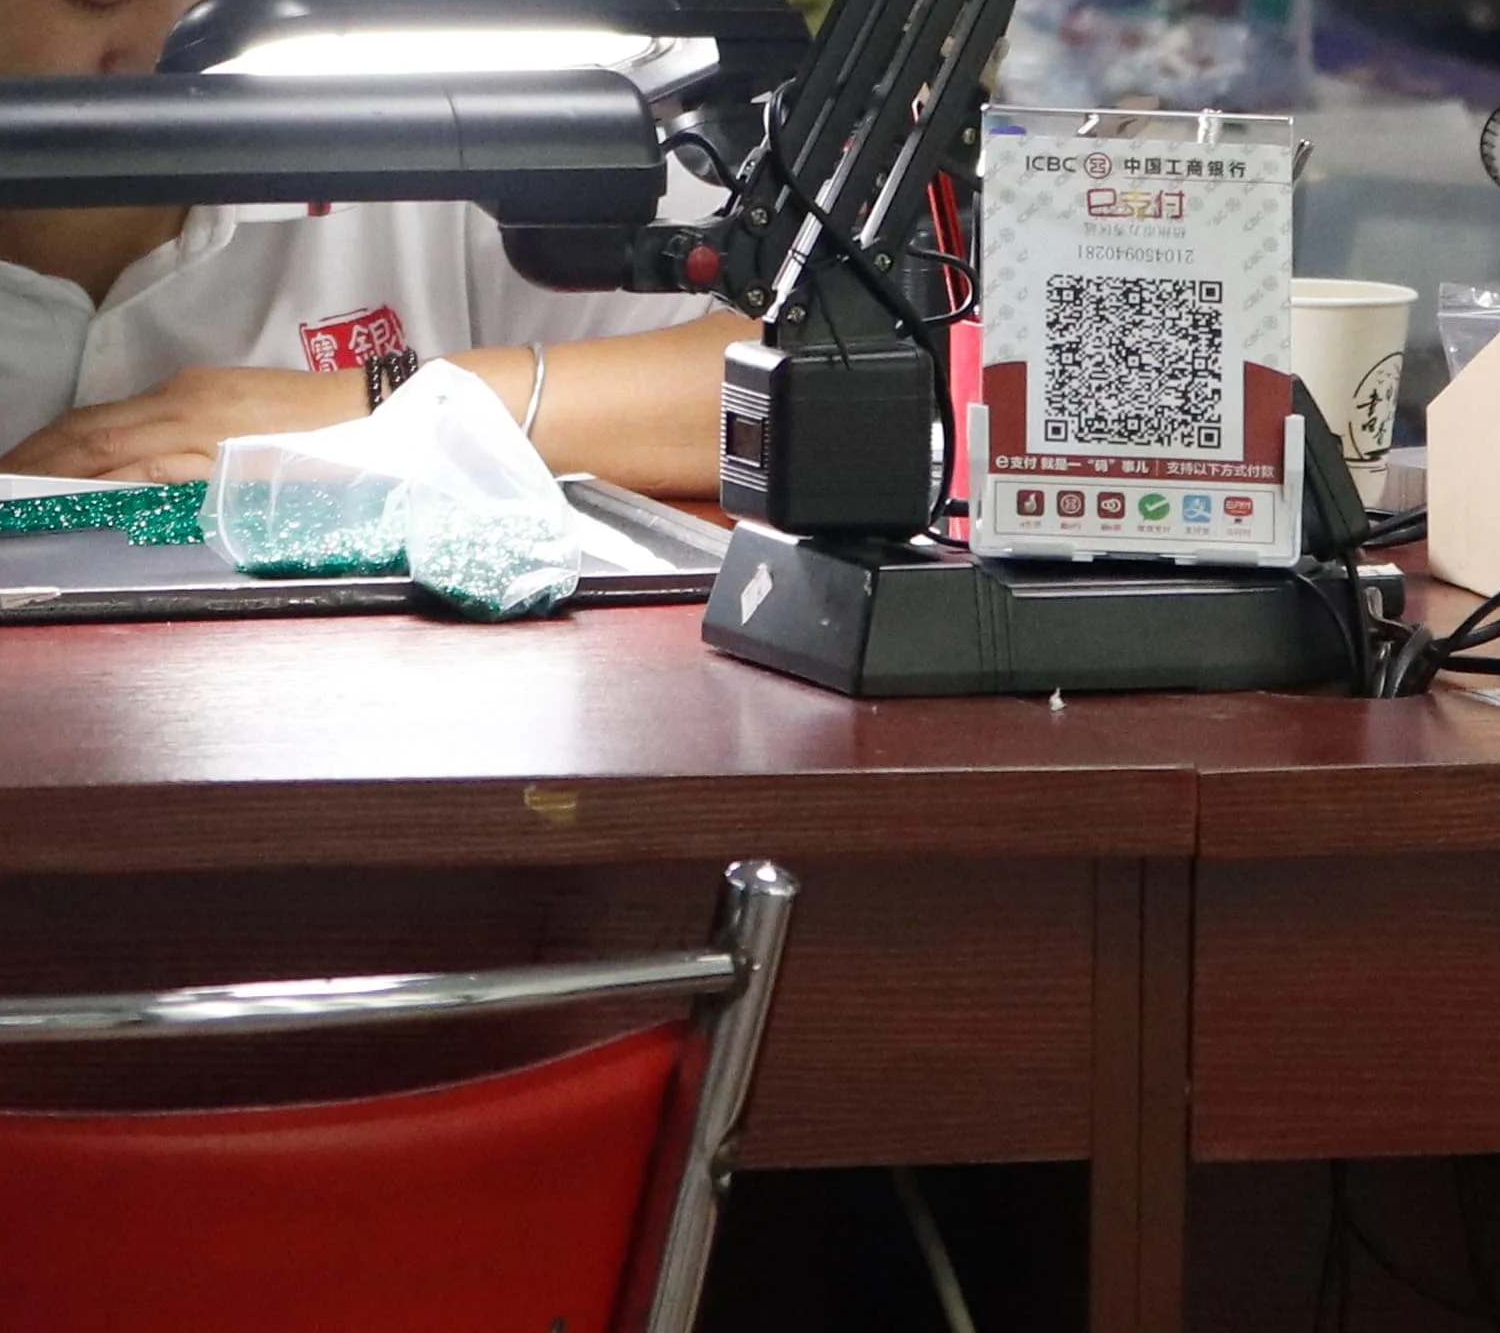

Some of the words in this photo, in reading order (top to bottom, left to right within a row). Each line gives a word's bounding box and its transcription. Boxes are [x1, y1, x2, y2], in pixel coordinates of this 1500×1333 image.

[1026, 156, 1077, 174] ICBC
[1124, 156, 1247, 178] 中国工商银行
[1167, 461, 1275, 478] 支持以下方式付款
